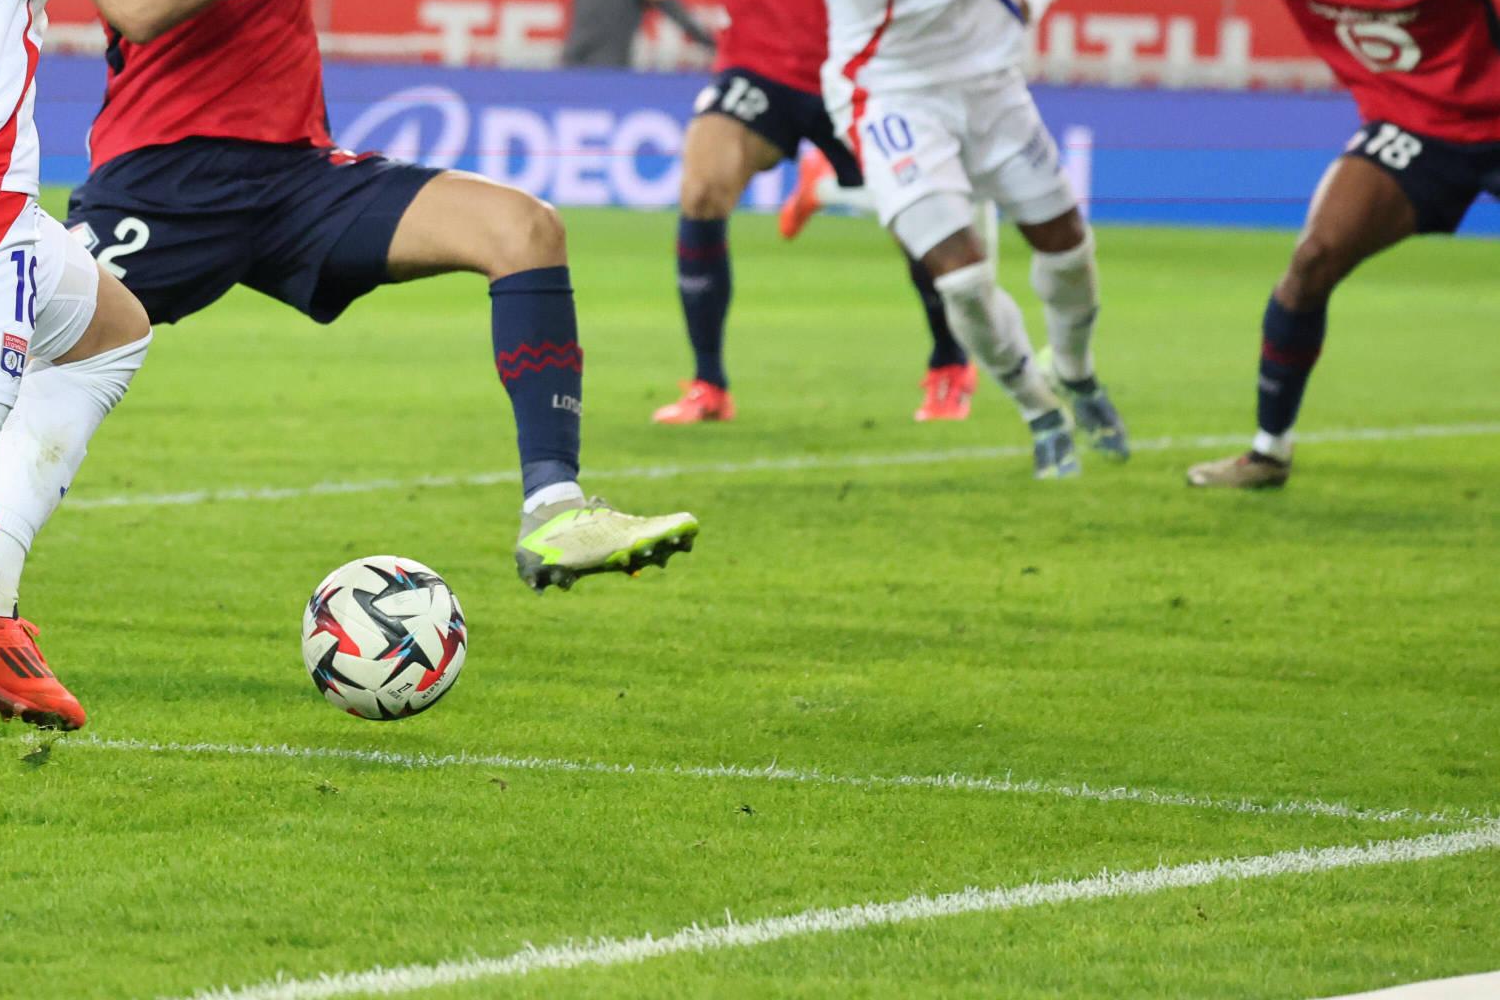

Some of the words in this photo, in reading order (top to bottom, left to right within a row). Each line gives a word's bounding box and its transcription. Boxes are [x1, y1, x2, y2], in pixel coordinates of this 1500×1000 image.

[867, 112, 914, 159] 10
[1365, 122, 1422, 170] 18
[552, 393, 582, 417] LOS
